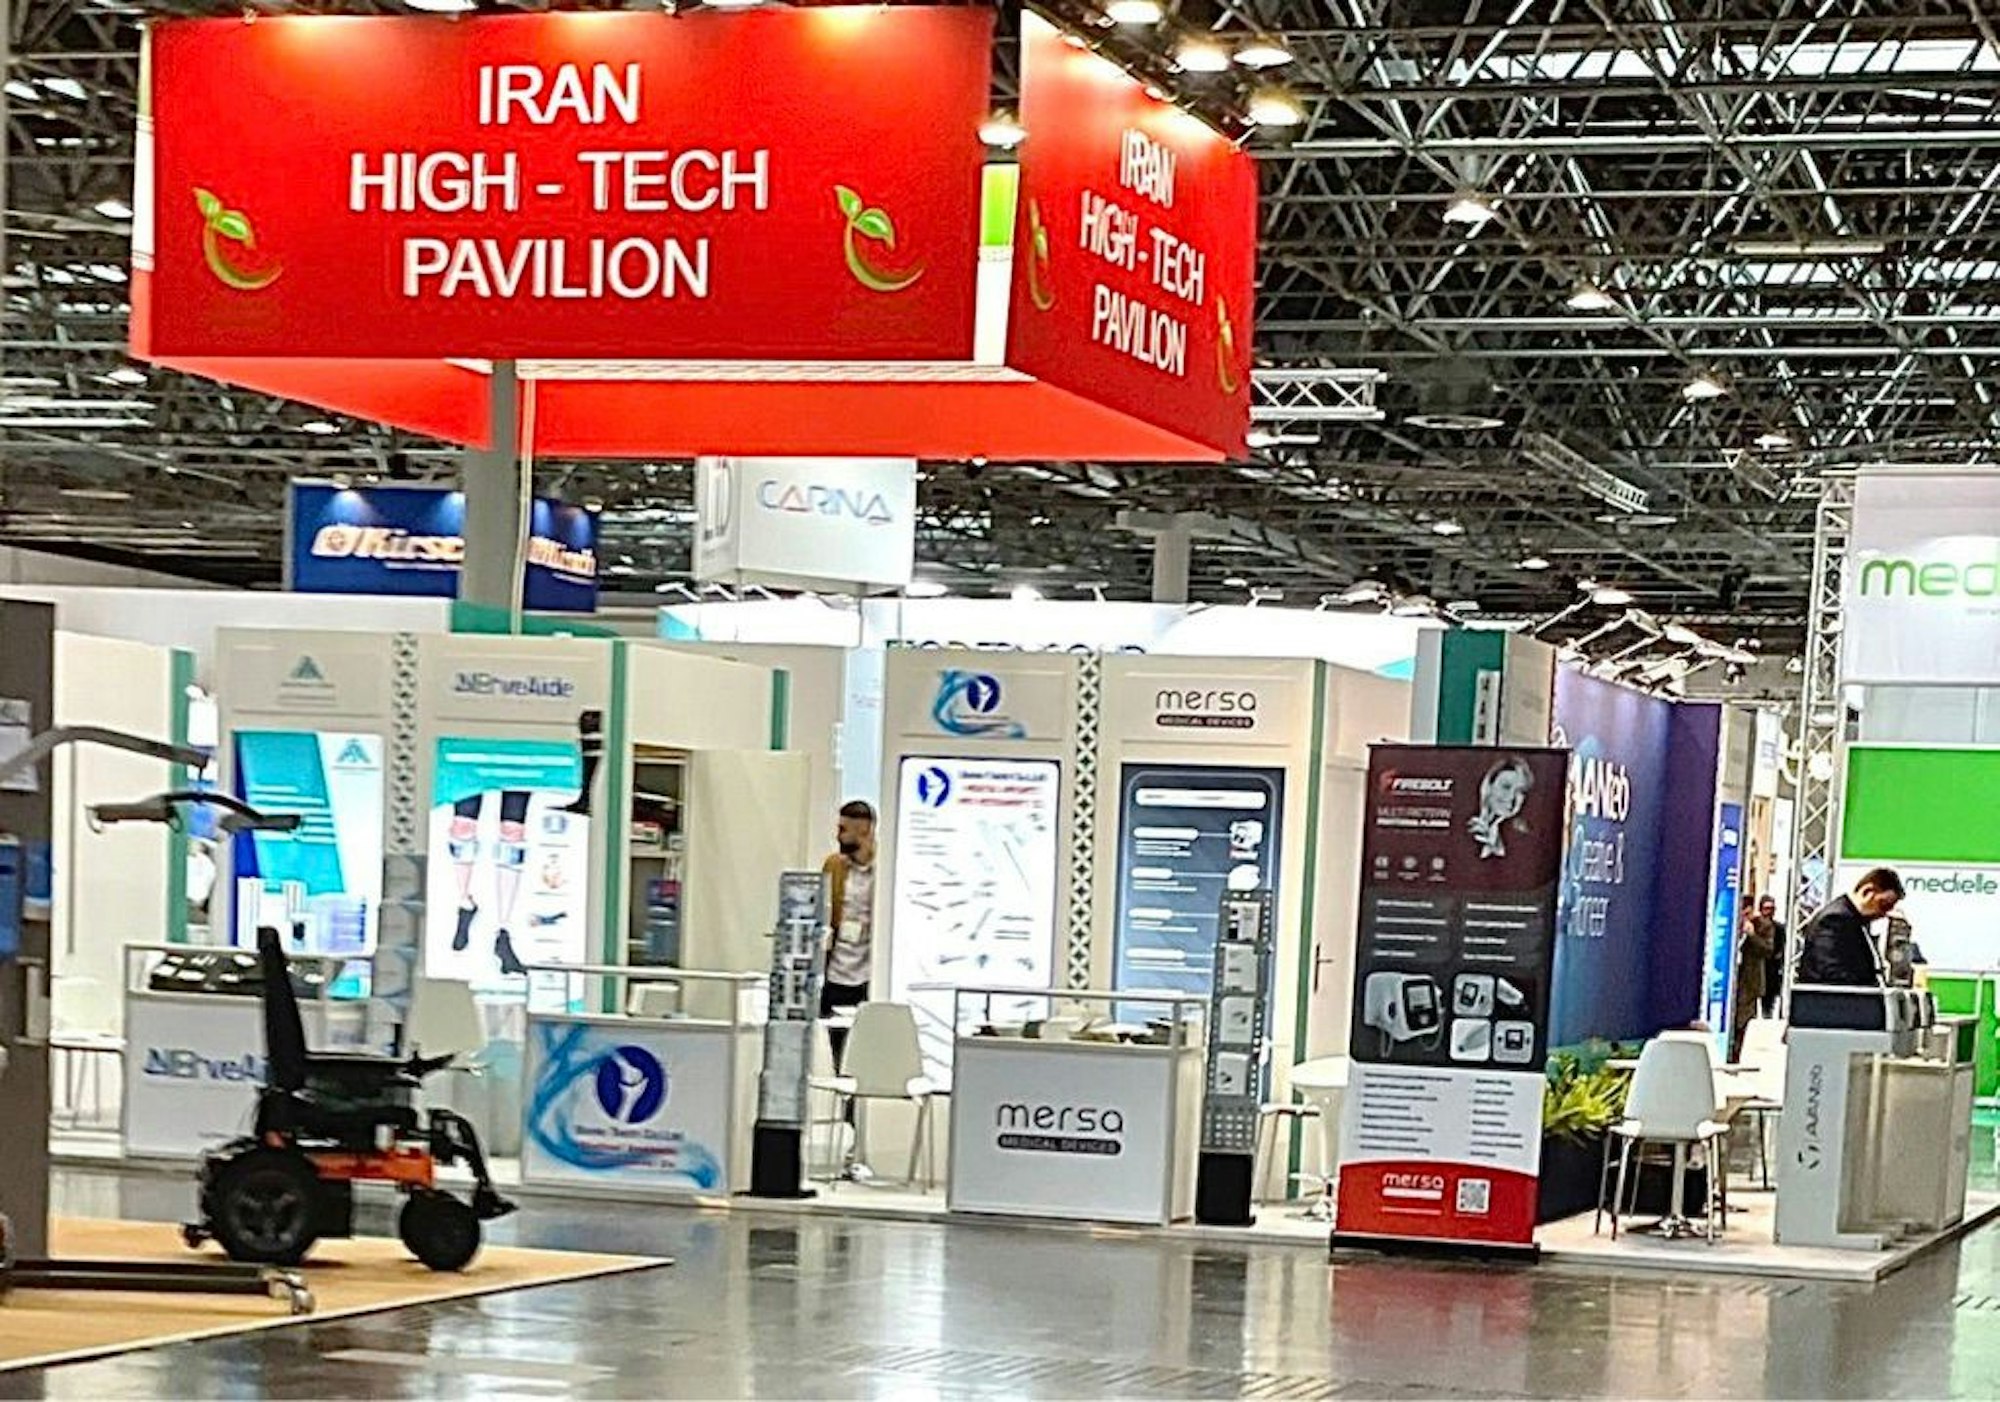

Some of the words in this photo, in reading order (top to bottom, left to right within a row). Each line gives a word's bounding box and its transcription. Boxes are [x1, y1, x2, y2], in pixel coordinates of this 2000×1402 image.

[478, 63, 640, 126] IRAN
[349, 151, 521, 213] HIGH
[536, 182, 565, 196] -
[577, 149, 770, 212] TECH
[1119, 129, 1176, 209] IRAN
[402, 236, 709, 299] PAVILION
[1079, 189, 1139, 272] HIGH
[1137, 251, 1149, 262] -
[1149, 227, 1206, 306] TECH
[1092, 284, 1188, 377] PAVILION
[1155, 691, 1256, 711] mersa
[1905, 873, 1998, 894] medielle
[997, 1104, 1124, 1133] mersa
[1001, 1136, 1057, 1149] MEDICAL
[1061, 1138, 1117, 1153] DEVICES
[1382, 1173, 1445, 1189] mersa
